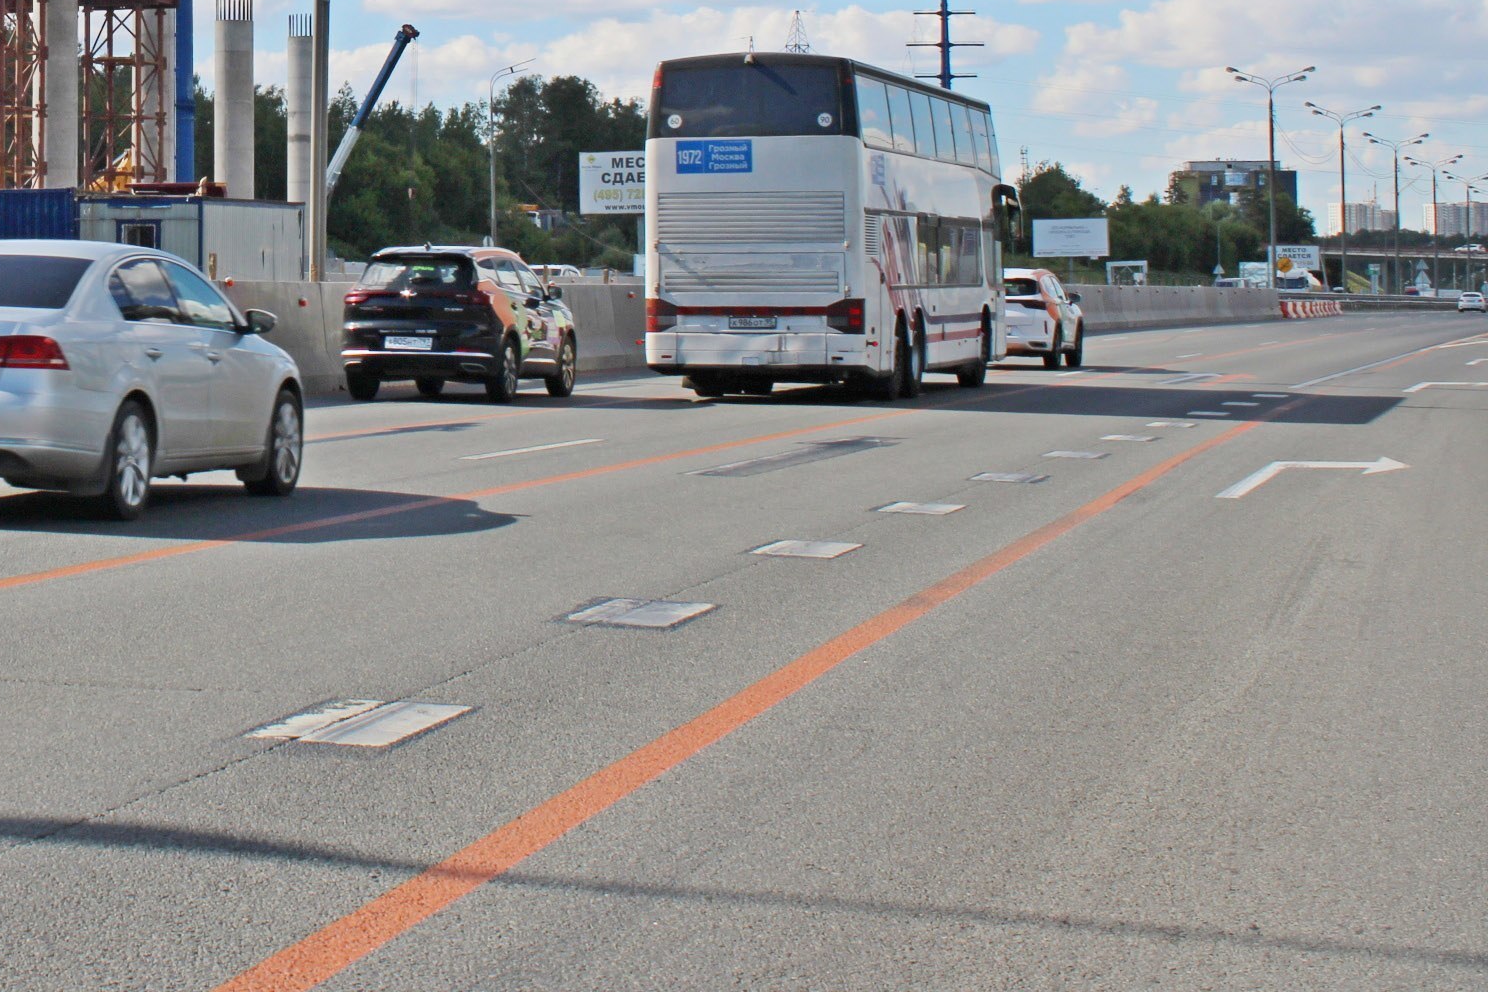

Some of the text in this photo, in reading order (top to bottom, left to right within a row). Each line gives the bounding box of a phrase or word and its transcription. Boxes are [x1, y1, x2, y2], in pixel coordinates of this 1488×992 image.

[708, 143, 748, 152] Грозный
[677, 150, 702, 165] 1972
[711, 153, 745, 161] Москва
[708, 161, 748, 171] Грозный
